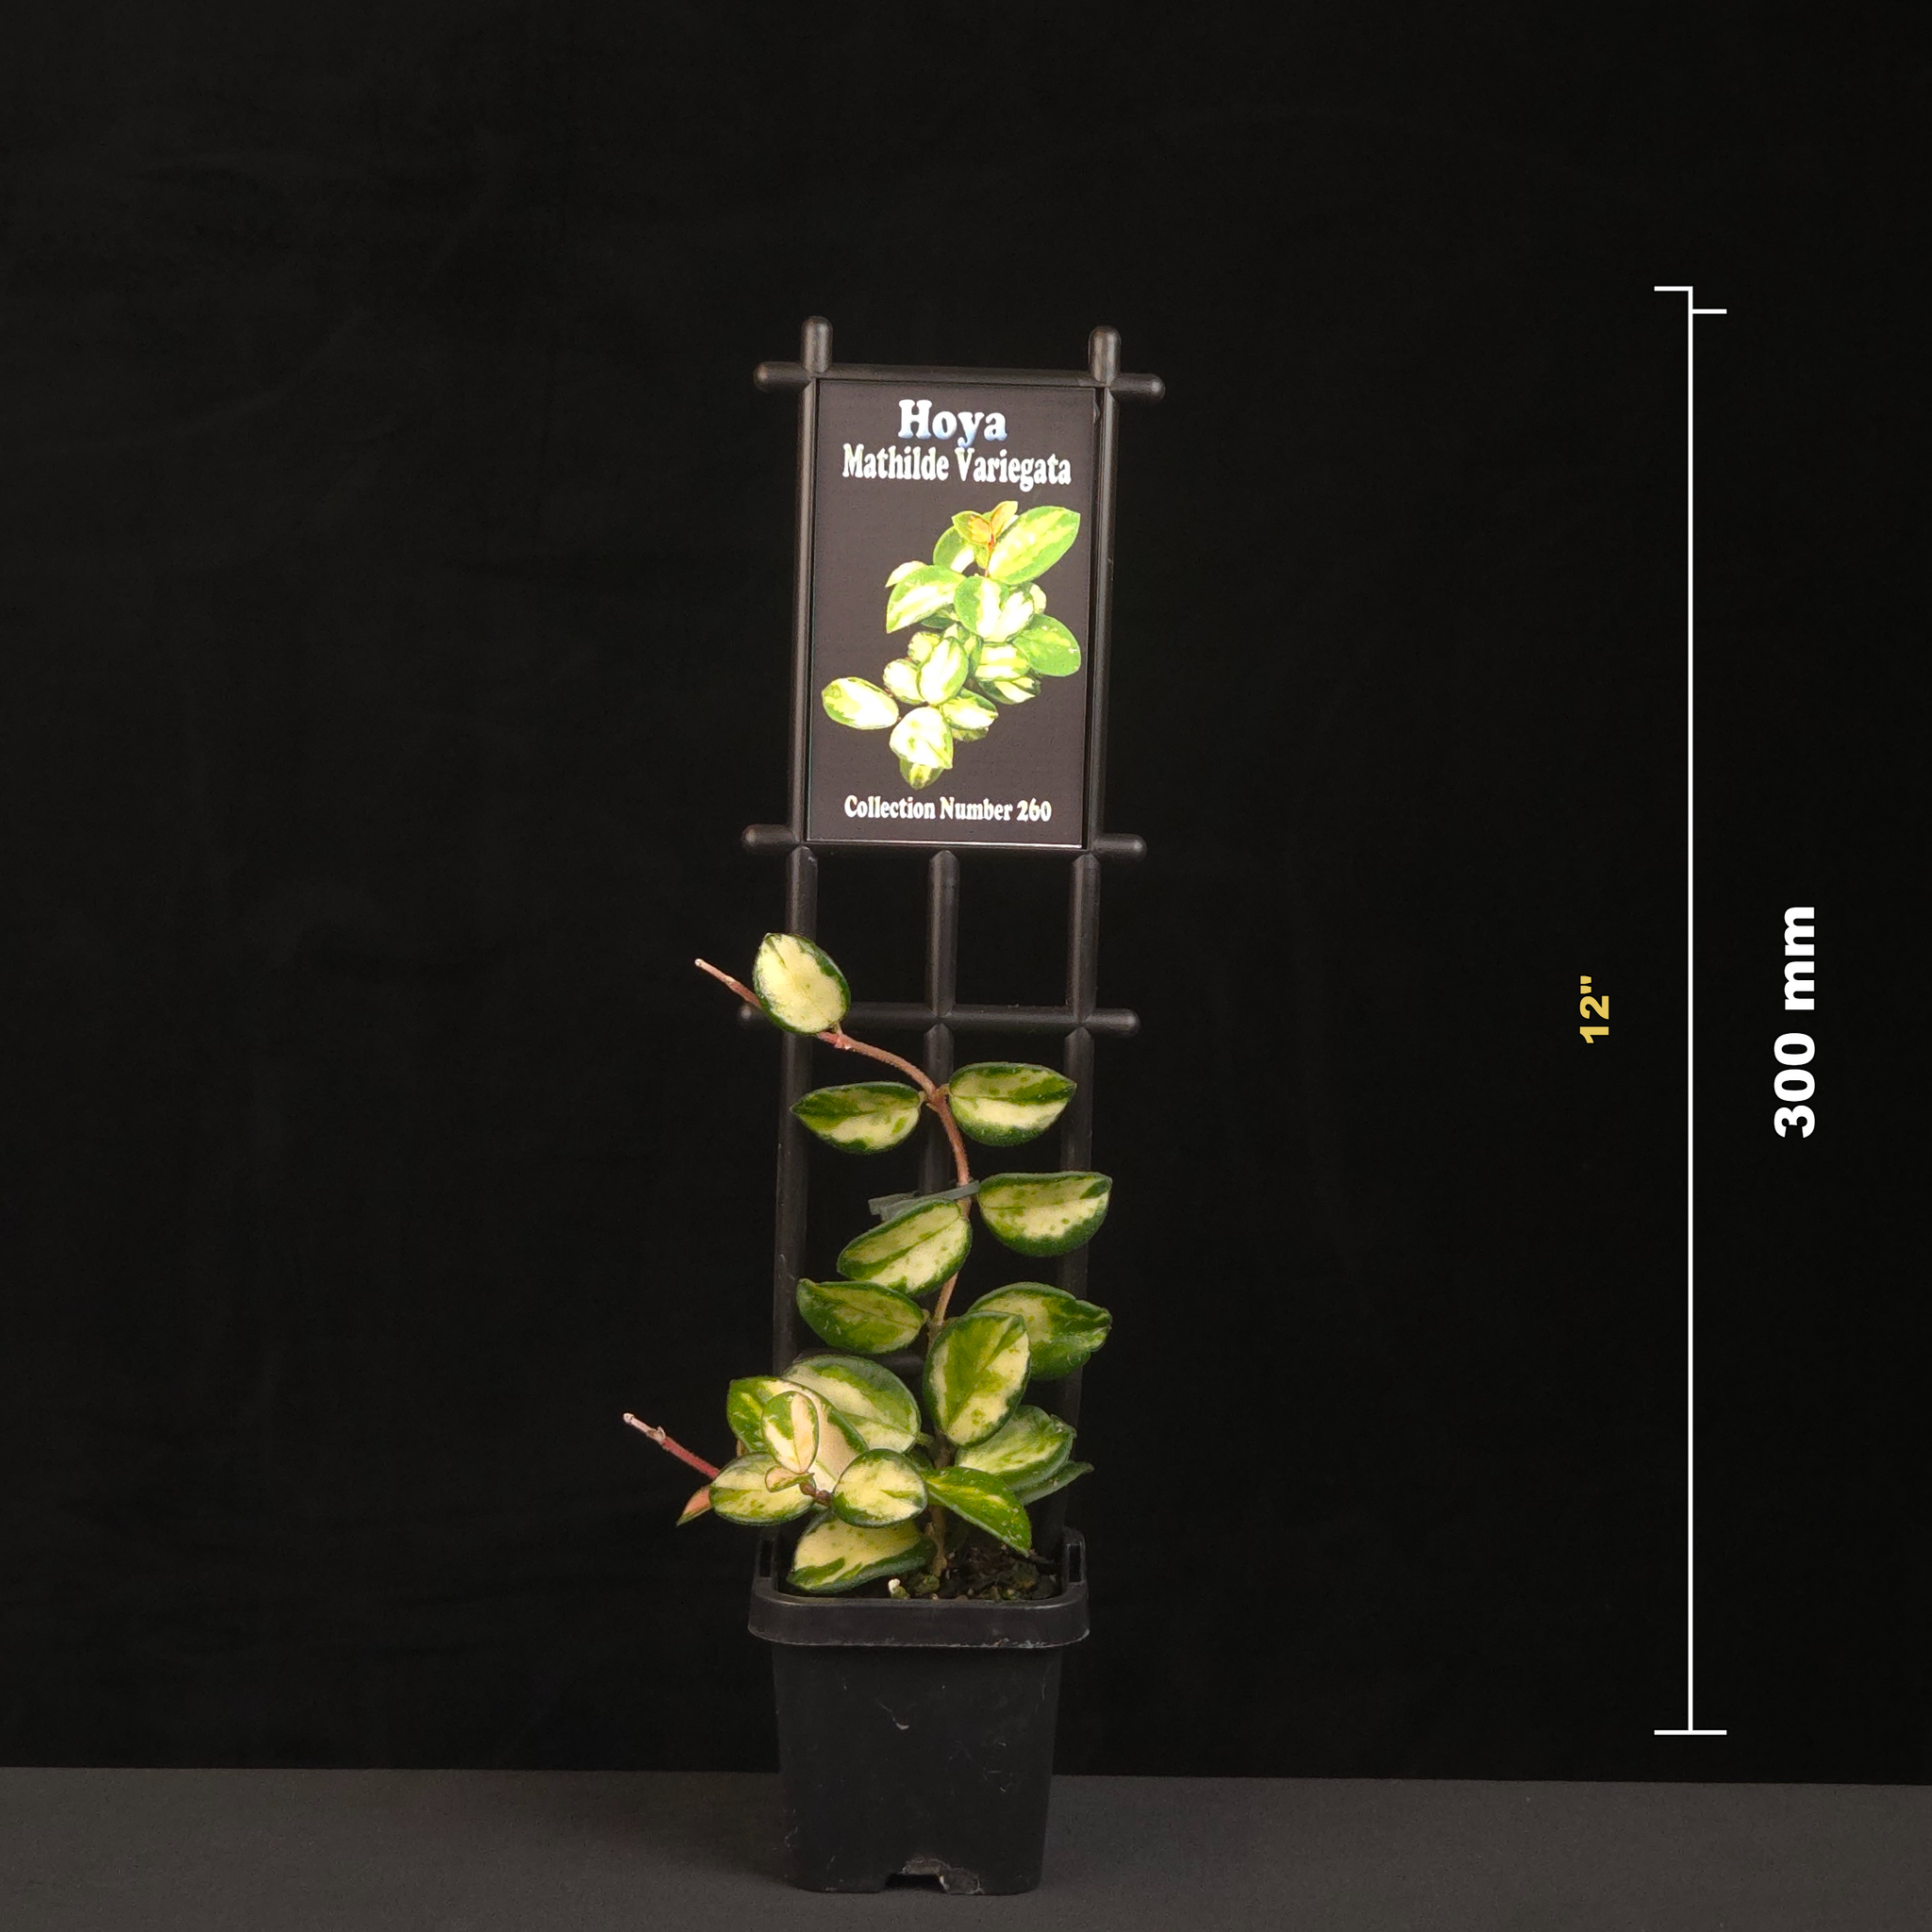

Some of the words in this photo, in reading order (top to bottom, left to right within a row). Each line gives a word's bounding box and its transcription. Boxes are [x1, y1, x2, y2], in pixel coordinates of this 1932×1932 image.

[898, 399, 1008, 447] Hoya
[842, 443, 949, 481] Mathilde
[955, 447, 1072, 492] Variegata
[844, 795, 936, 820] Collection
[940, 796, 1013, 821] Number
[1016, 798, 1052, 822] 260
